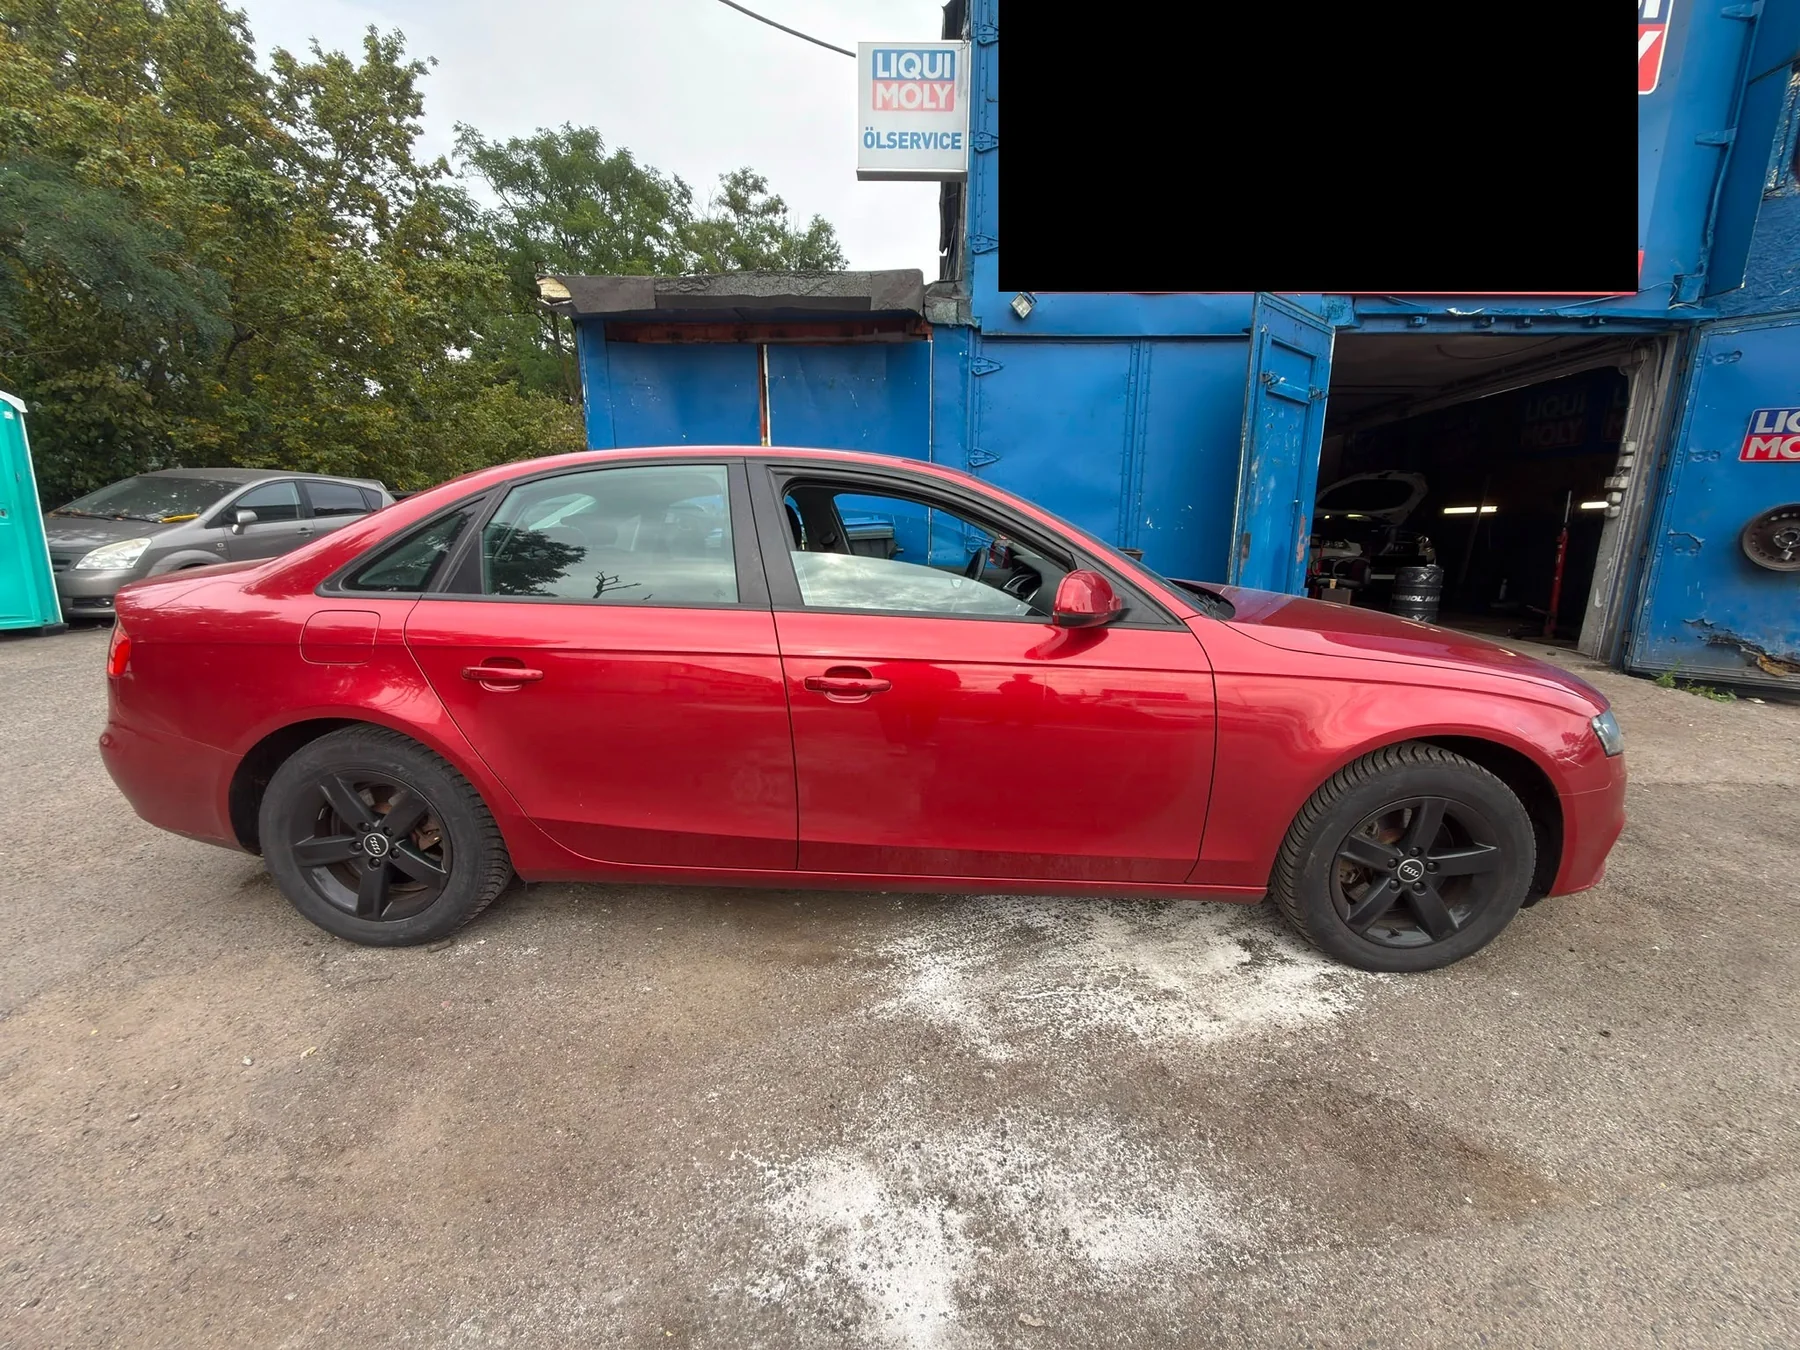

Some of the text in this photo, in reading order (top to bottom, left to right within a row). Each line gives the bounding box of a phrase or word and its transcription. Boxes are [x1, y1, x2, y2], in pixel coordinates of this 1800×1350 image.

[876, 52, 951, 80] LIQUI
[876, 82, 953, 109] MOLY
[863, 126, 962, 150] ÖLSERVICE
[1526, 393, 1587, 423] LIQUI
[1519, 417, 1584, 447] MOLY
